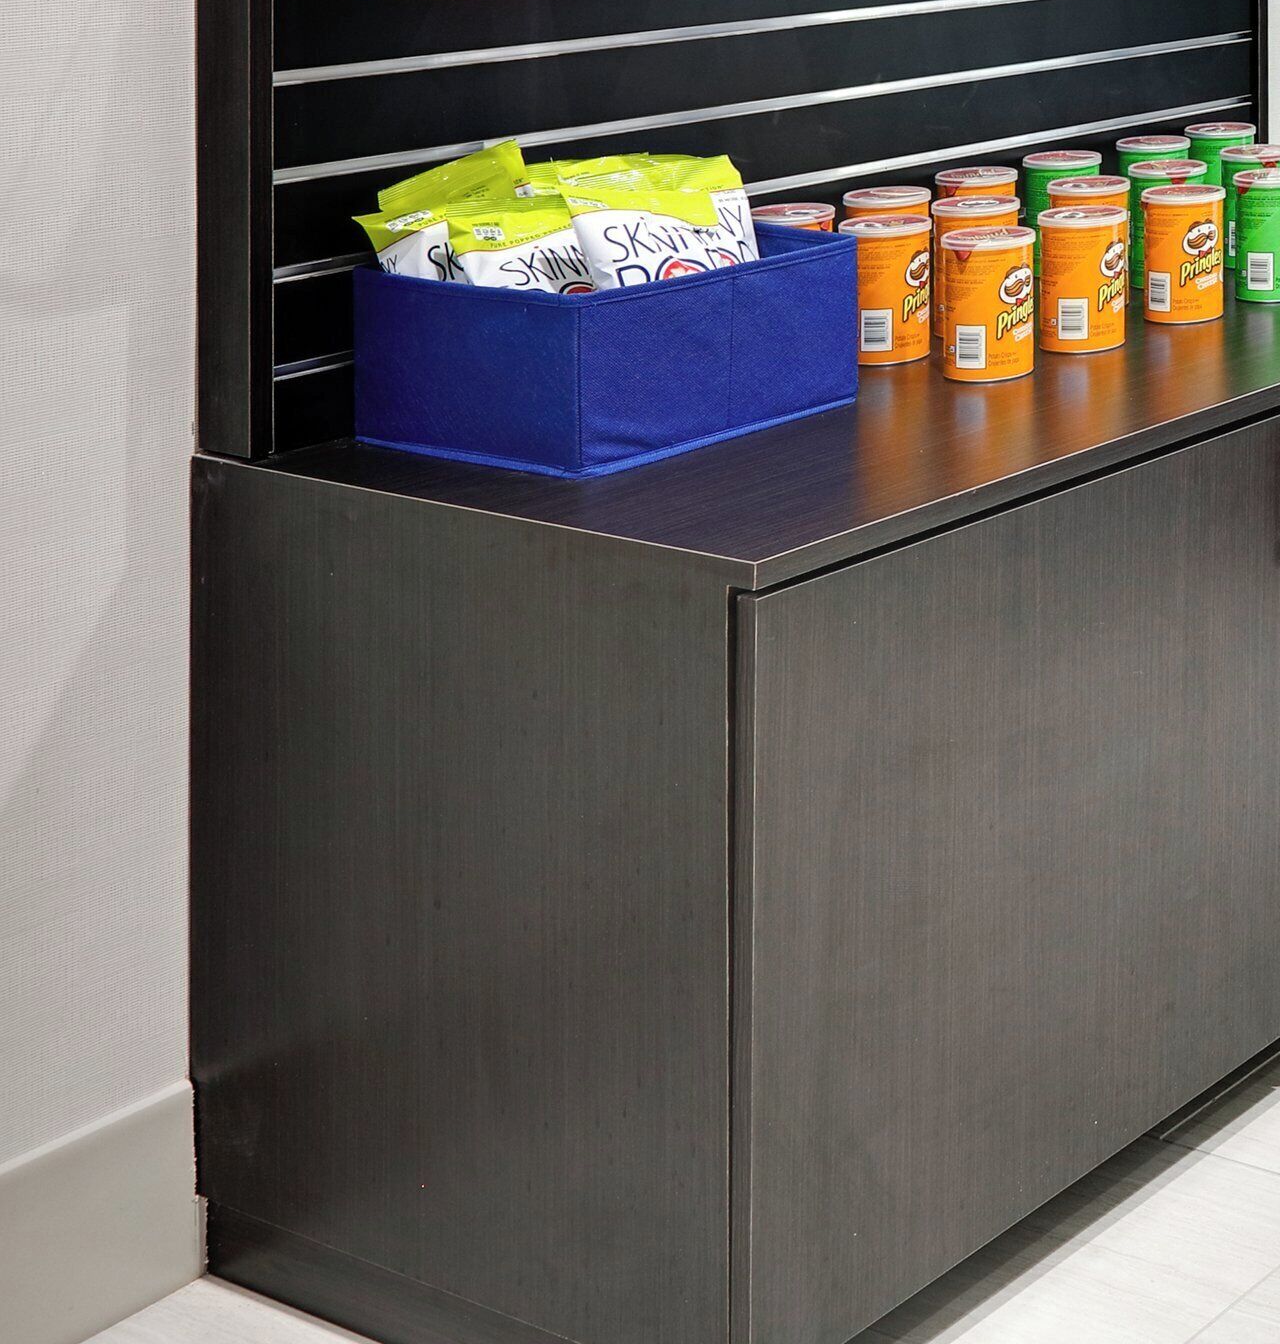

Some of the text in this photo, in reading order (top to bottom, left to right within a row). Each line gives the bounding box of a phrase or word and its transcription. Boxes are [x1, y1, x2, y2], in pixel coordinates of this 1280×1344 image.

[1179, 249, 1223, 287] Pringles
[902, 287, 930, 323] Pring
[1097, 271, 1126, 312] Pring
